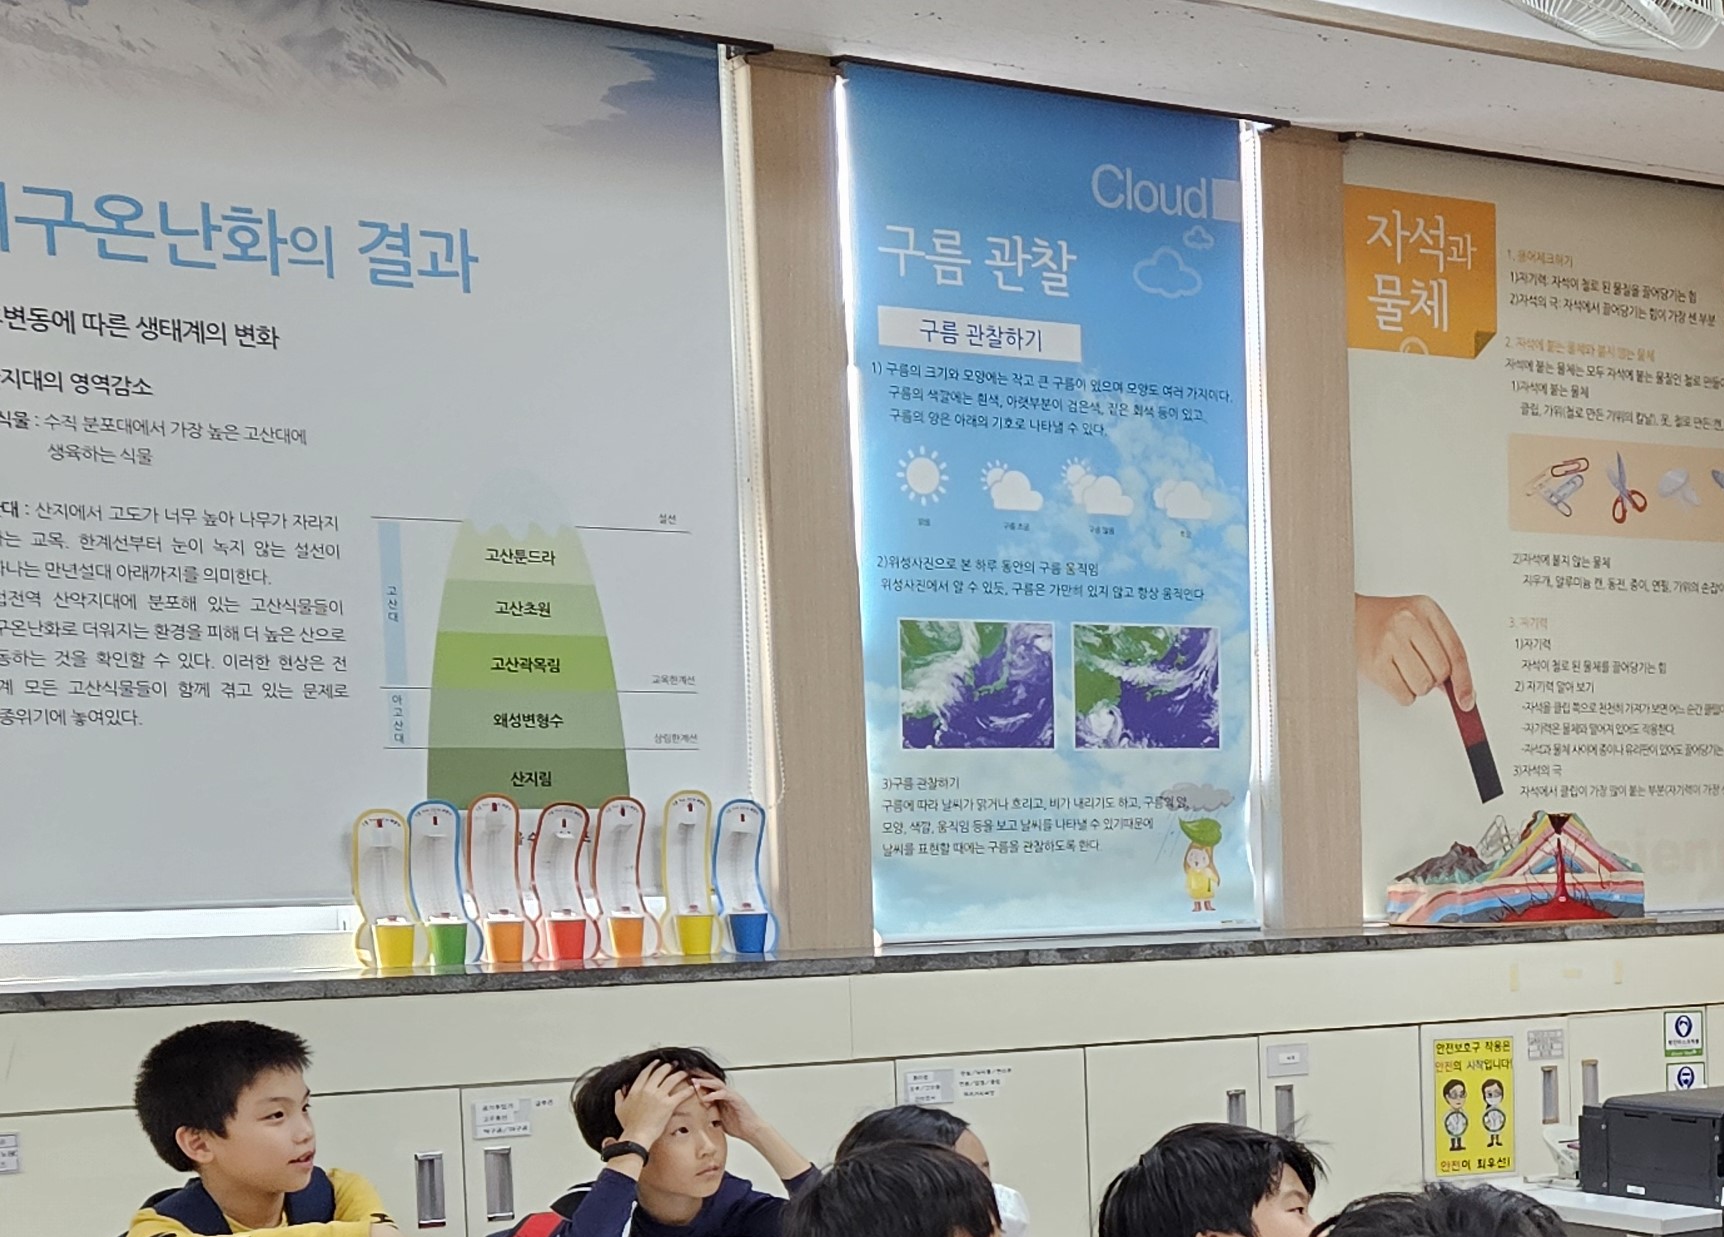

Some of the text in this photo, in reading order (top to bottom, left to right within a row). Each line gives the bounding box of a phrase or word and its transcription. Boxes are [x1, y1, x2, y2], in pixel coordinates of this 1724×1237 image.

[1091, 163, 1207, 220] Cloud
[1366, 209, 1477, 274] 자석과
[358, 218, 480, 294] 결과
[877, 224, 1078, 298] 구름 관찰
[1367, 271, 1449, 333] 물체
[82, 311, 130, 339] 따른
[136, 316, 227, 346] 생태계의
[235, 323, 281, 350] 변화
[919, 318, 1043, 353] 구름 관찰하기
[70, 373, 154, 397] 영역감소
[871, 362, 1233, 402] 1) 구름의 크기와 모양에는 작고 큰 구름이 있으며 모양도 여러 가지이다.
[44, 415, 77, 431] 수직
[83, 417, 166, 435] 분포대에서
[170, 422, 203, 439] 가장
[208, 424, 240, 441] 높은
[244, 427, 307, 444] 고산대에
[890, 409, 1108, 436] 구름의 양은 아래의 기호로 나타낼 수 있다.
[47, 445, 152, 465] 생육하는 식물
[35, 503, 339, 531] 산지에서 고도가 너무 높아 나무가 자라지
[31, 532, 340, 559] 교목. 한계선부터 눈이 녹지 않는 설선이
[484, 548, 556, 566] 고산툰드라
[960, 559, 972, 571] 본
[975, 560, 997, 572] 하루
[1001, 560, 1035, 574] 동안의
[1039, 562, 1062, 575] 구름
[1066, 563, 1099, 576] 움직임
[44, 563, 272, 585] 만년설대 아래까지를 의미한다.
[881, 579, 949, 592] 위성사진에서
[952, 580, 964, 593] 알
[967, 581, 978, 593] 수
[982, 582, 1009, 595] 있듯,
[1011, 583, 1046, 596] 구름은
[1049, 584, 1083, 597] 가만히
[1087, 585, 1109, 597] 있지
[1112, 586, 1135, 598] 않고
[53, 593, 344, 615] 산악지대에 분포해 있는 고산식물들이
[387, 585, 399, 622] 고산대
[495, 601, 551, 618] 고산초원
[82, 623, 150, 639] 더워지는
[154, 624, 202, 640] 환경을
[207, 626, 240, 641] 피해
[243, 626, 259, 641] 더
[264, 627, 295, 642] 높은
[299, 628, 346, 643] 산으로
[54, 651, 88, 667] 것을
[96, 652, 145, 668] 확인할
[154, 653, 171, 668] 수
[177, 653, 215, 669] 있다.
[222, 655, 270, 670] 이러한
[332, 656, 347, 671] 전
[24, 680, 58, 696] 모든
[68, 681, 167, 697] 고산식물들이
[178, 682, 210, 698] 함께
[261, 683, 294, 699] 있는
[303, 684, 350, 699] 문제로
[0, 709, 142, 726] 종위기에 놓여있다.
[493, 713, 564, 729] 왜성변형수
[510, 770, 552, 788] 산지림
[1436, 1039, 1511, 1055] 안전보호구 착용은
[1435, 1060, 1462, 1073] 안전의
[1440, 1159, 1471, 1173] 안전이
